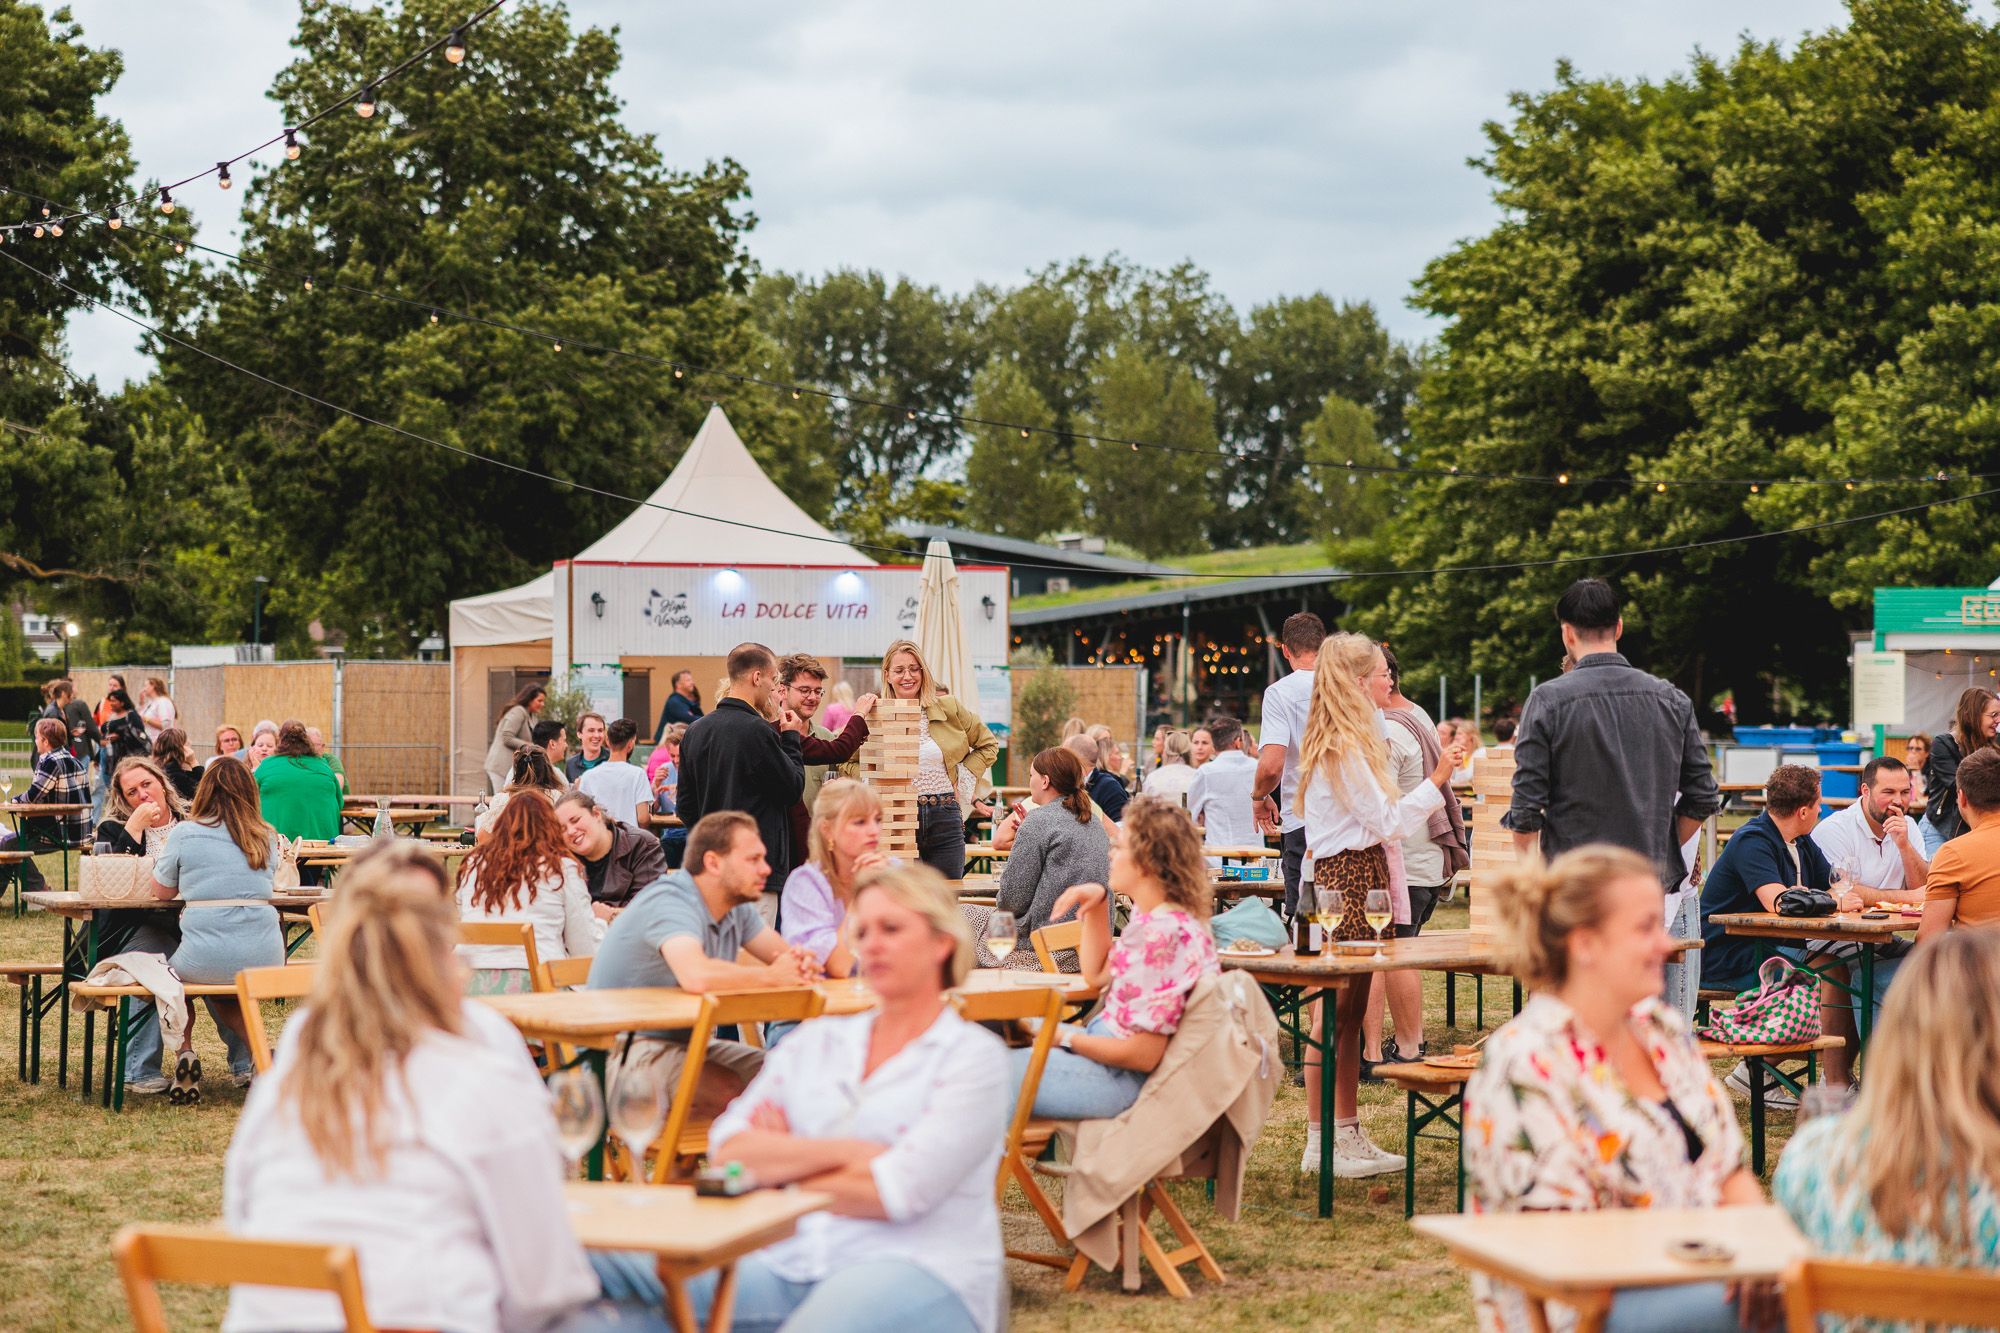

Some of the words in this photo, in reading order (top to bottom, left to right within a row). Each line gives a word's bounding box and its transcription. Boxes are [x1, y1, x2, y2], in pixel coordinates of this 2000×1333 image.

[721, 602, 746, 619] LA
[755, 602, 818, 619] DOLCE
[826, 602, 869, 620] VITA
